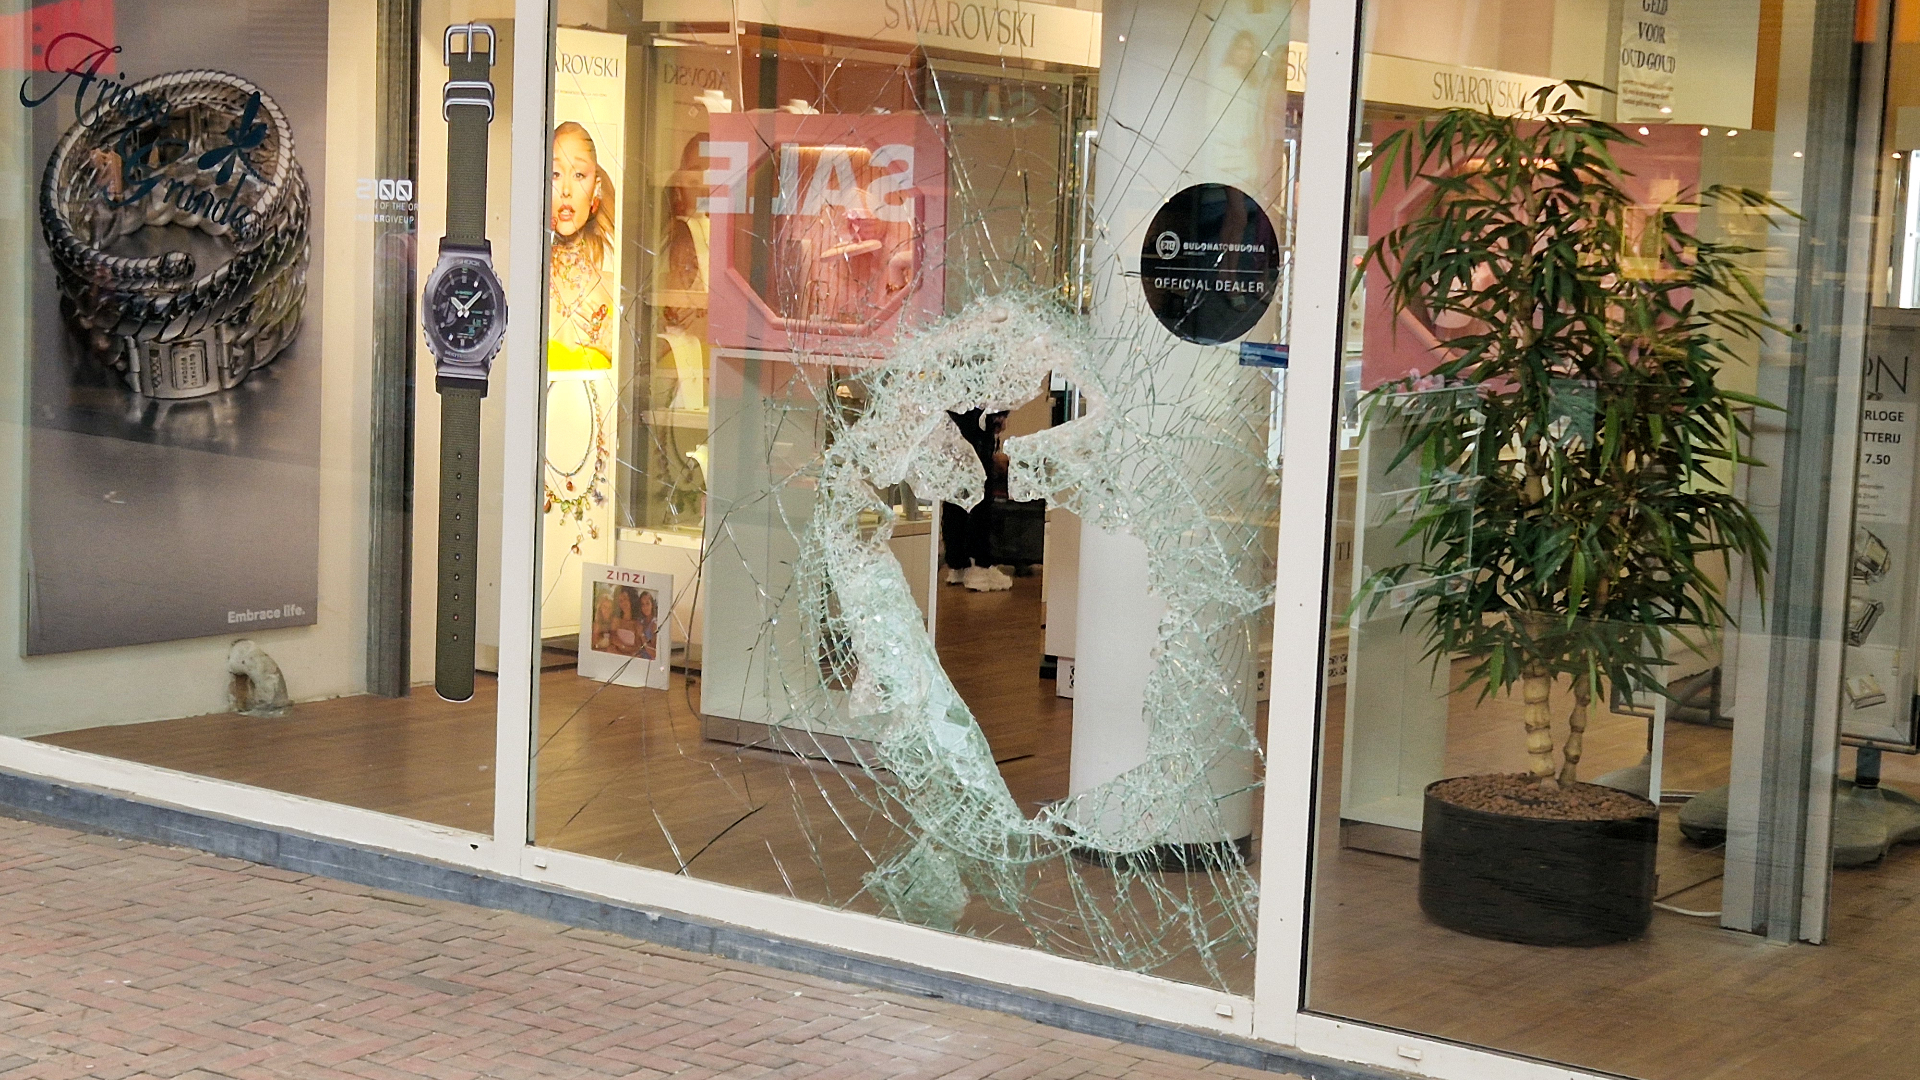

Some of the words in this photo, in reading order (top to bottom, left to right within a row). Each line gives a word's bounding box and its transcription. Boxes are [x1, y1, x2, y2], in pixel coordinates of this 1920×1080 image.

[884, 0, 1036, 48] SWAROVSKI
[1638, 22, 1666, 44] VOOR
[1621, 48, 1646, 69] OUD
[1646, 52, 1676, 74] GOUD
[1432, 71, 1523, 109] SWAROVSKI
[1154, 277, 1210, 292] OFFICIAL
[1215, 280, 1265, 293] DEALER
[1865, 453, 1891, 466] 7.50
[227, 608, 281, 624] Embrace
[283, 603, 306, 618] life.
